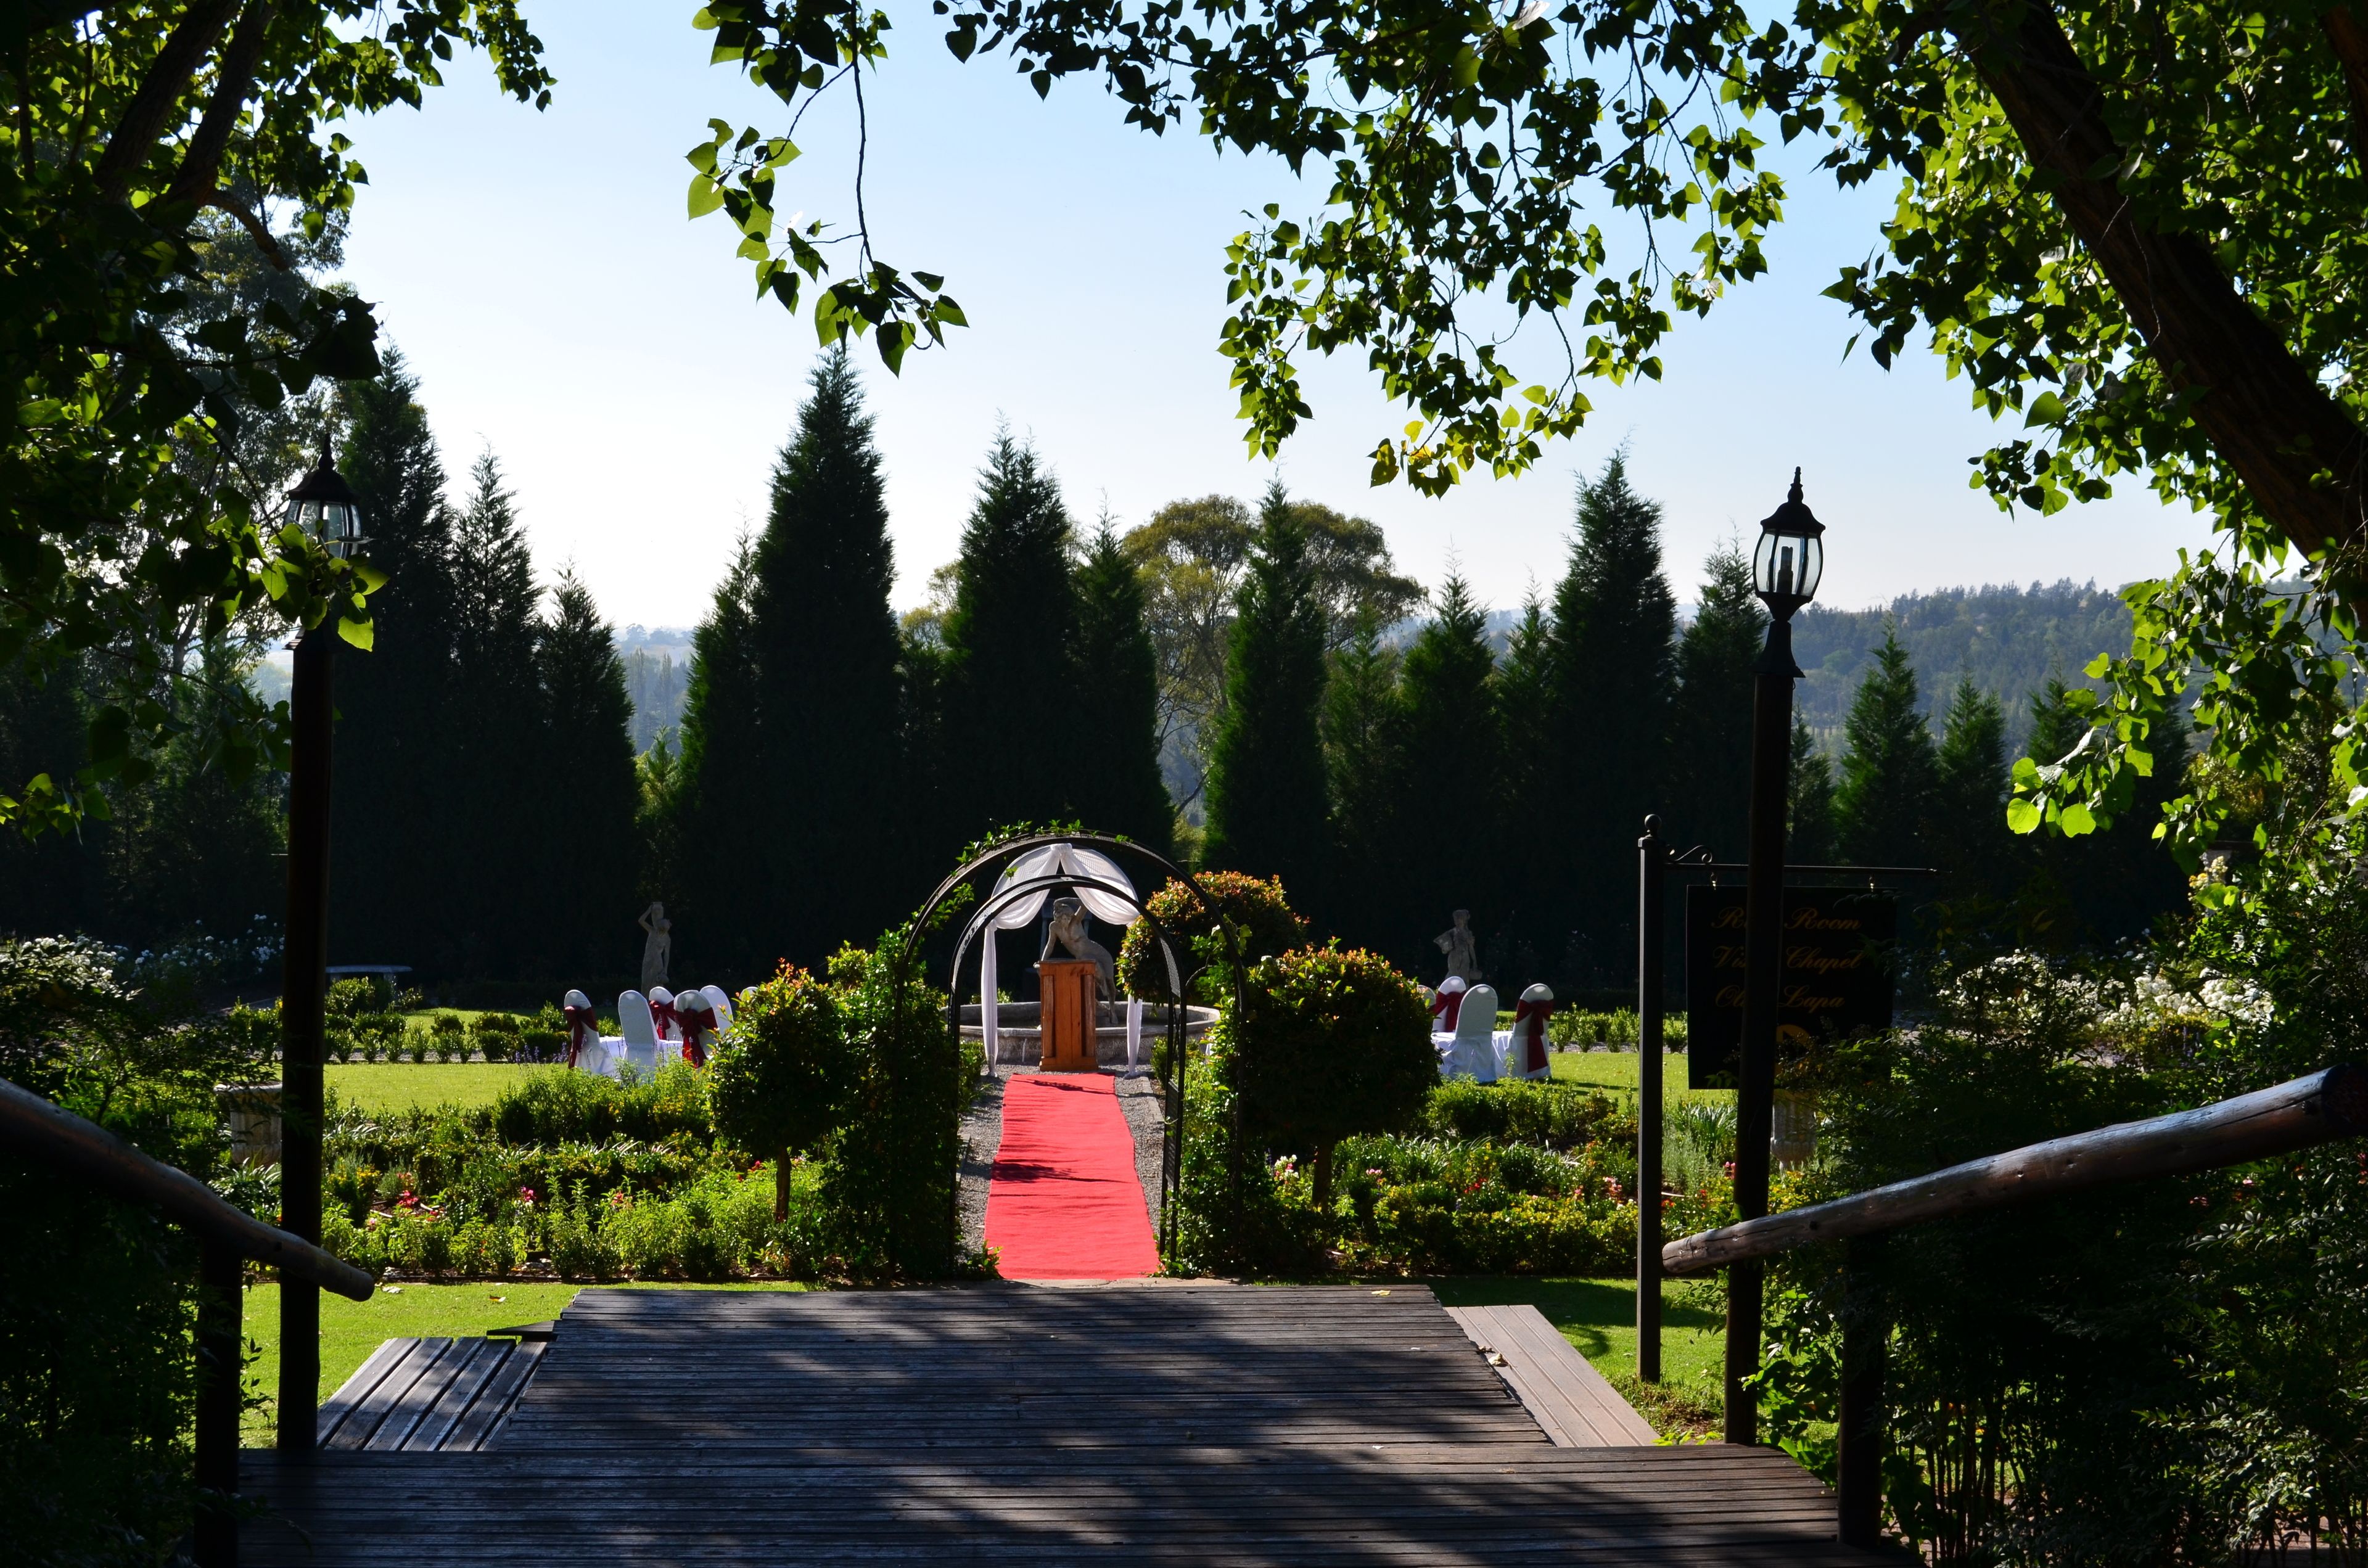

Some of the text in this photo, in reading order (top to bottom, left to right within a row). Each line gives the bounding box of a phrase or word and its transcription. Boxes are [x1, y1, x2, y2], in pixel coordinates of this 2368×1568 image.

[1784, 906, 1862, 930] Room
[1785, 945, 1866, 975] Chapel
[1777, 984, 1846, 1014] Lapa
